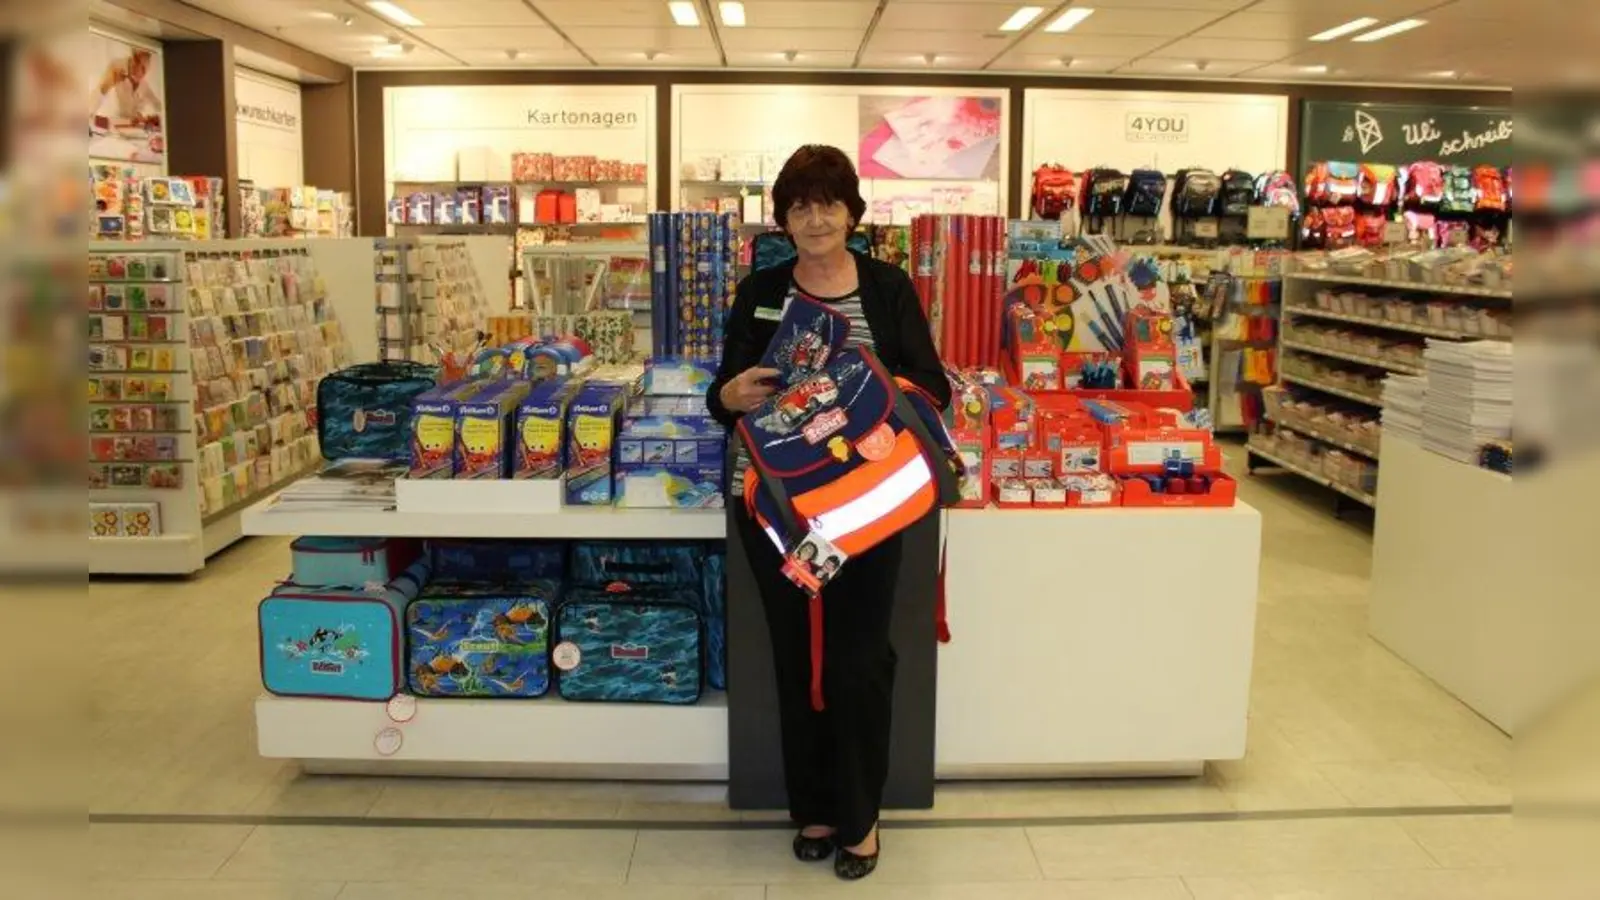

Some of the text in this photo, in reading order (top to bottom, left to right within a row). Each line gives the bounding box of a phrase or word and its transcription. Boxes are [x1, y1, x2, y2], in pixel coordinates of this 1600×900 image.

[526, 108, 638, 129] Kartonagen
[1131, 116, 1184, 132] 4YOU
[1401, 118, 1442, 145] Uli
[1438, 120, 1513, 157] schreib
